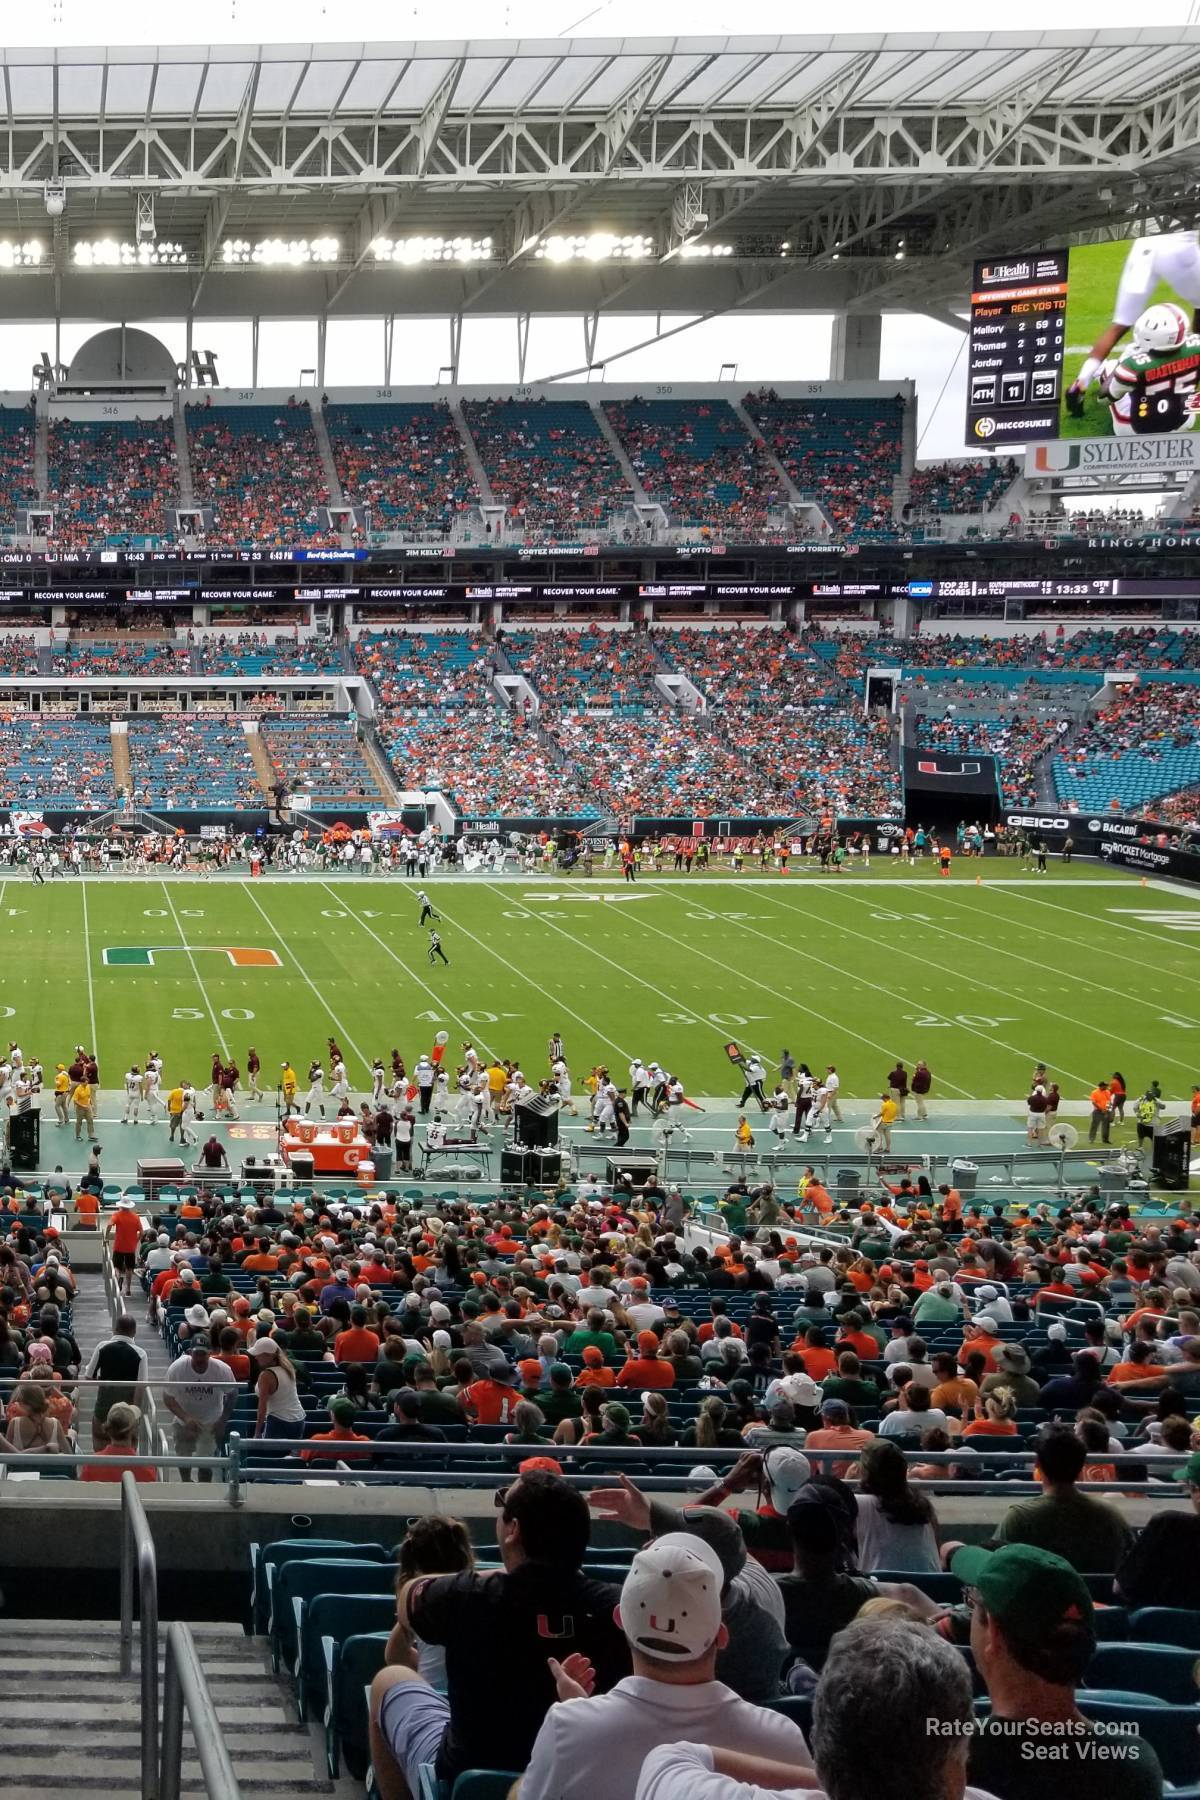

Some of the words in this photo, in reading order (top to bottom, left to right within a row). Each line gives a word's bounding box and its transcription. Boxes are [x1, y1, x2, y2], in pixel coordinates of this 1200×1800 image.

[978, 290, 1017, 302] OFFENSIVE
[1038, 286, 1060, 295] STATS
[975, 306, 1003, 318] Player
[1011, 303, 1030, 313] REC
[1032, 301, 1052, 311] YDS
[1053, 300, 1066, 309] TD
[973, 324, 1005, 336] Mallory
[1019, 322, 1026, 331] 2
[1055, 318, 1063, 328] 0
[973, 340, 1007, 352] Thomas
[1017, 339, 1024, 348] 2
[1036, 337, 1047, 346] 10
[1055, 335, 1062, 345] 0
[972, 357, 1003, 369] Jordan
[1034, 354, 1047, 364] 27
[1054, 352, 1061, 362] 0
[376, 390, 392, 398] 348
[515, 388, 532, 396] 349
[655, 386, 673, 394] 350
[807, 385, 823, 393] 351
[973, 388, 994, 401] 4TH
[1008, 385, 1019, 398] 11
[1035, 383, 1053, 396] 33
[238, 392, 254, 400] 347
[102, 406, 119, 415] 346
[995, 418, 1052, 431] MICCOSUKEE
[1083, 438, 1194, 464] SYLVESTER
[1083, 462, 1138, 472] COMPREHENSIVE
[1139, 461, 1167, 470] CANCER
[1167, 459, 1194, 469] CENTER
[1088, 538, 1134, 548] RING
[5, 554, 23, 563] CMU
[63, 554, 79, 562] MIA
[124, 553, 145, 561] 14:43
[210, 553, 219, 561] 11
[717, 587, 747, 595] RECOVER
[749, 587, 768, 595] YOUR
[939, 581, 957, 589] TOP
[958, 581, 969, 589] 25
[1056, 584, 1089, 594] 13:33
[34, 592, 63, 600] RECOVER
[65, 592, 83, 600] YOUR
[370, 589, 400, 597] RECOVER
[402, 589, 421, 597] YOUR
[543, 588, 573, 596] RECOVER
[575, 588, 594, 596] YOUR
[938, 588, 971, 596] SCORES
[463, 821, 500, 832] UHealth
[1007, 815, 1070, 830] GEICO
[1102, 822, 1137, 837] BACARDÍ
[1112, 842, 1140, 857] ROCKET
[1140, 848, 1171, 865] Mortgage
[170, 1006, 256, 1020] 50
[413, 1009, 500, 1023] 40
[656, 1012, 749, 1025] 30
[901, 1014, 999, 1028] 20
[343, 1149, 360, 1166] G
[499, 1397, 509, 1424] 1
